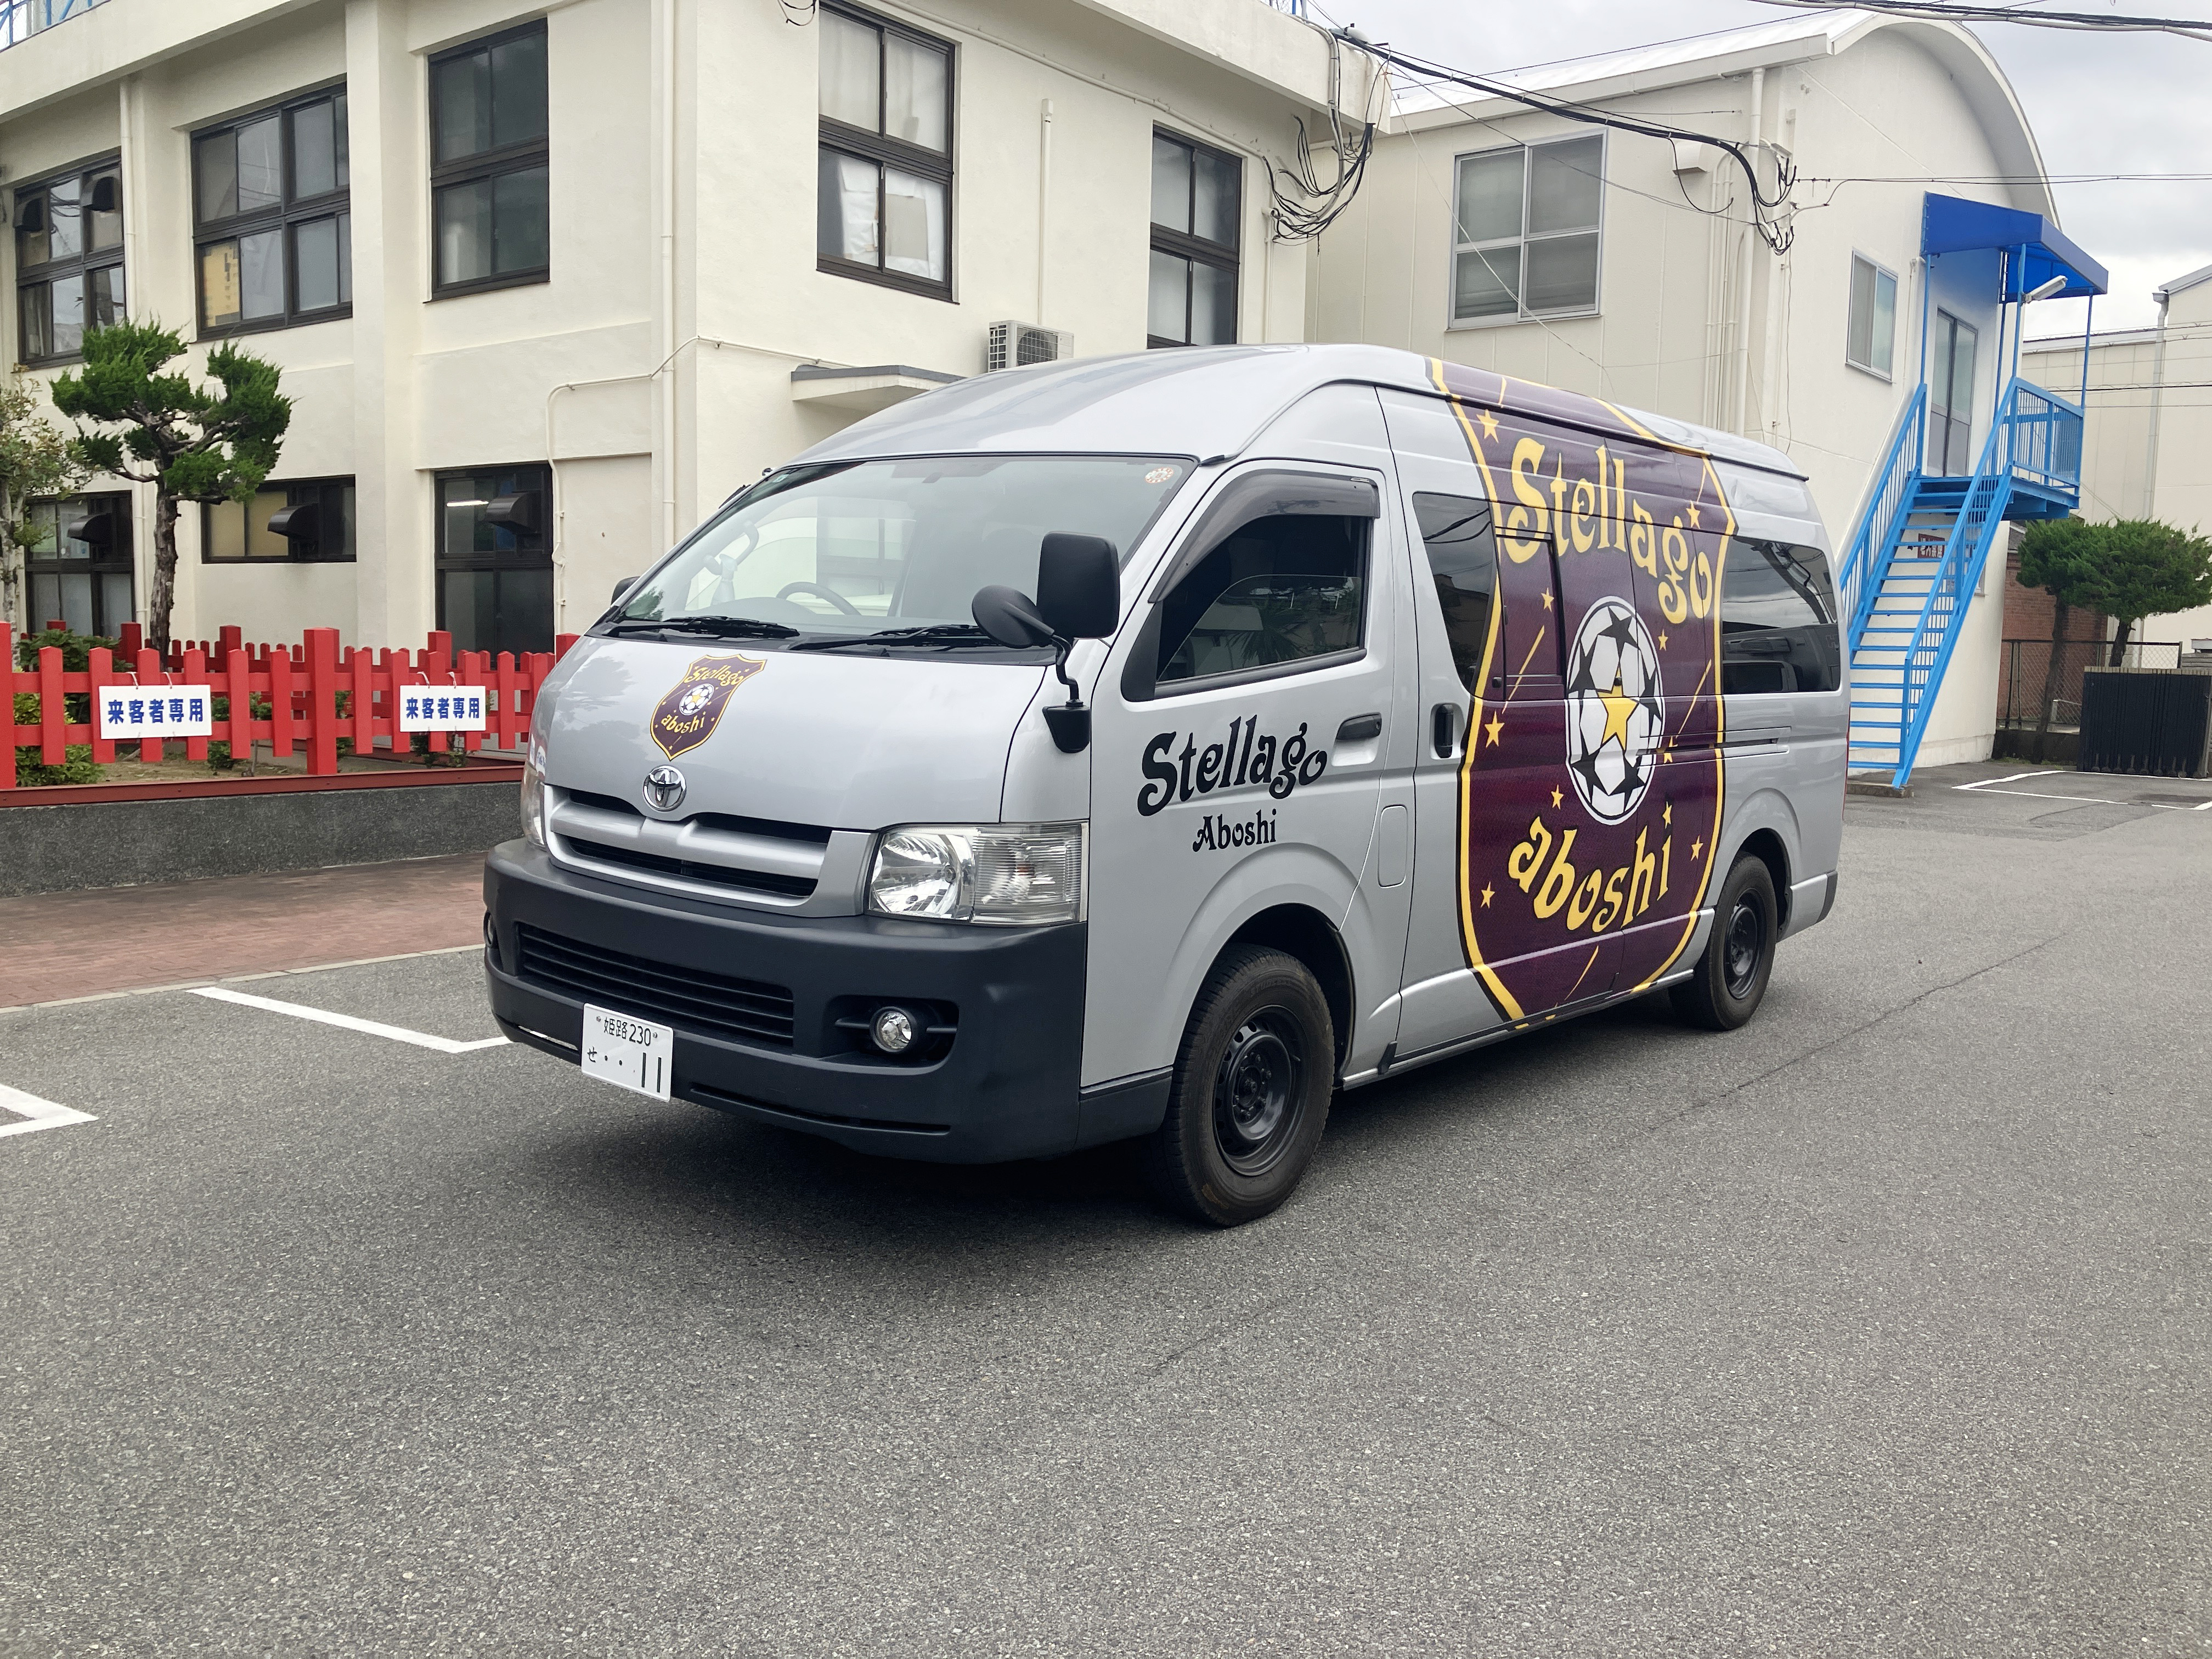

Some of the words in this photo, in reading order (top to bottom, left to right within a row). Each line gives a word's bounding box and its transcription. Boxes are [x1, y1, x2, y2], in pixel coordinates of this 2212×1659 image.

[1505, 437, 1712, 624] Stellago
[684, 664, 744, 686] Stellago
[108, 698, 204, 724] 来客者専用
[405, 697, 479, 720] 来客者専用
[661, 711, 706, 734] aboshi
[1137, 714, 1328, 816] Stellago
[1192, 808, 1277, 853] Aboshi
[1508, 802, 1672, 933] aboshi
